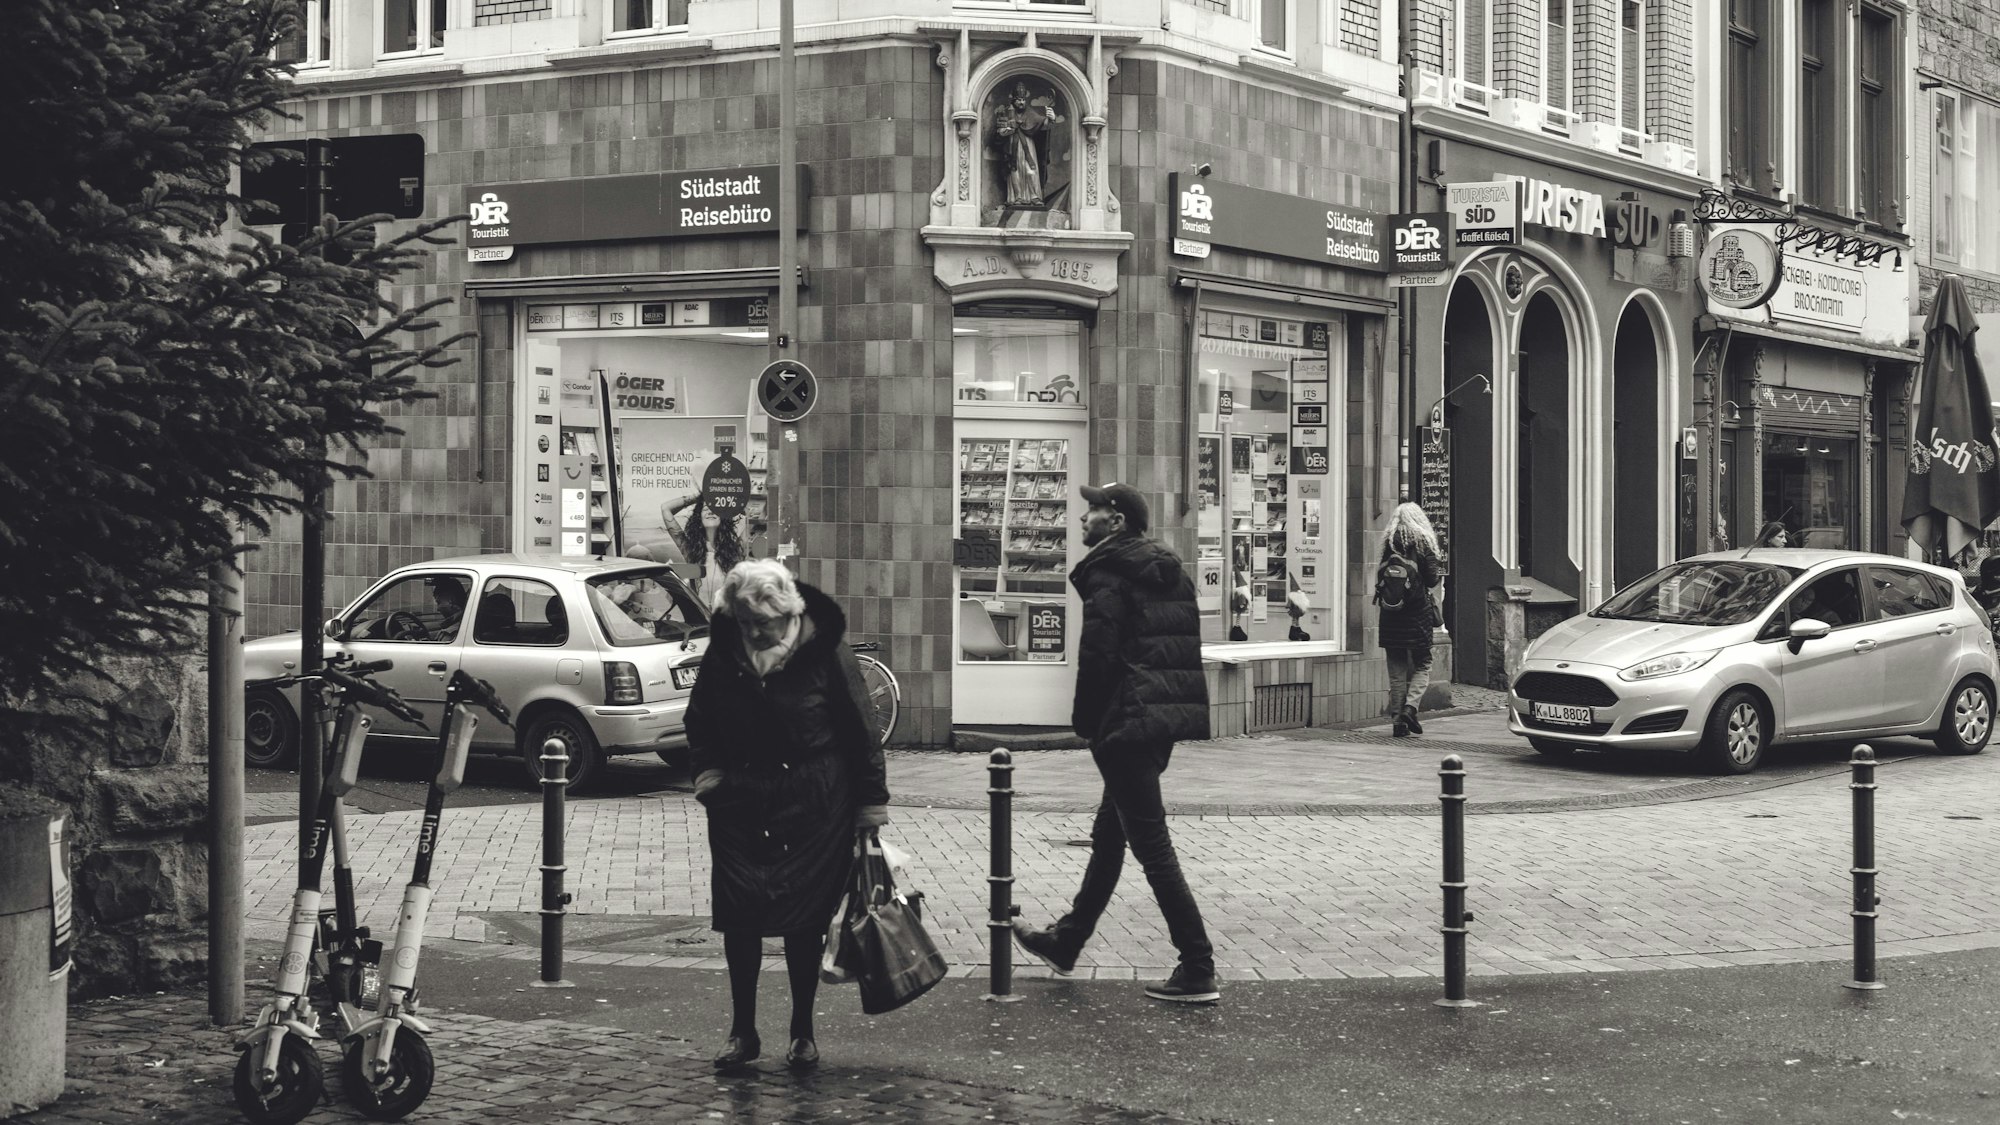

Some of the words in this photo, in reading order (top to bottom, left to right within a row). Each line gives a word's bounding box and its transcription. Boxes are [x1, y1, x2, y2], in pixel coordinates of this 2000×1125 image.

[680, 175, 761, 199] Südstadt
[1452, 187, 1510, 204] TURISTA
[470, 199, 509, 226] DER
[1181, 189, 1214, 221] DER
[1522, 175, 1607, 238] URISTA
[680, 205, 771, 227] Reisebüro
[1465, 204, 1496, 224] SÜD
[1614, 192, 1662, 248] SÜD
[1181, 219, 1211, 235] Touristik
[1326, 211, 1374, 237] Südstadt
[472, 228, 509, 239] Touristik
[1395, 225, 1442, 250] DER
[1461, 231, 1484, 242] Gaffel
[1485, 231, 1510, 242] Kölsch
[473, 248, 505, 260] Partner
[1178, 241, 1203, 255] Partner
[1326, 237, 1379, 264] Reisebüro
[1396, 251, 1441, 263] Touristik
[963, 256, 1008, 277] A.D.
[1051, 258, 1098, 284] 1895.
[1399, 275, 1438, 286] Partner
[1818, 273, 1862, 297] KONDITOREI
[530, 313, 561, 324] DERTOUR
[610, 312, 624, 321] ITS
[779, 337, 784, 345] 2
[1312, 329, 1326, 343] DER
[616, 372, 664, 392] ÖGER
[959, 387, 986, 401] ITS
[1303, 389, 1317, 398] ITS
[616, 394, 675, 410] TOURS
[631, 453, 694, 463] GRIECHENLAND
[1306, 454, 1327, 467] DER
[631, 465, 654, 475] FRÜH
[656, 466, 692, 476] BUCHEN,
[631, 478, 654, 488] FRÜH
[656, 479, 691, 488] FREUEN!
[1032, 613, 1061, 628] DER
[1535, 704, 1543, 717] K
[1548, 706, 1562, 719] LL
[1563, 707, 1589, 721] 8802
